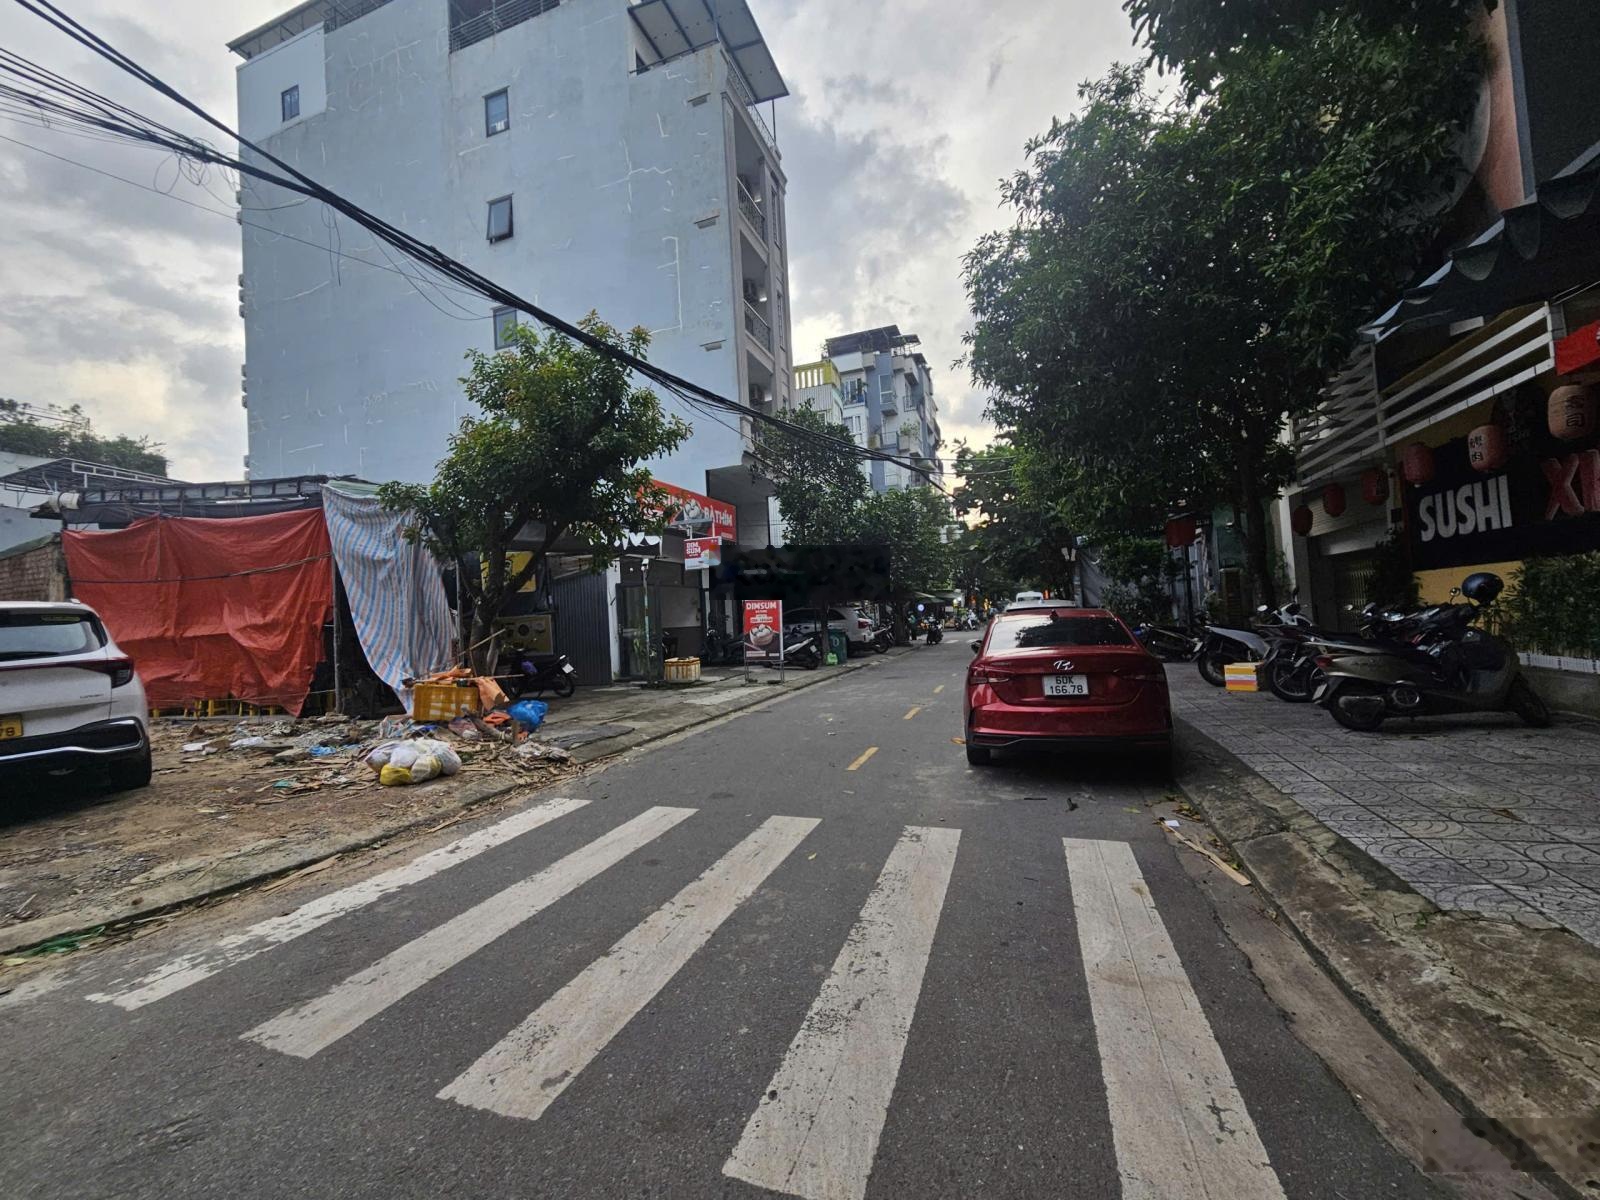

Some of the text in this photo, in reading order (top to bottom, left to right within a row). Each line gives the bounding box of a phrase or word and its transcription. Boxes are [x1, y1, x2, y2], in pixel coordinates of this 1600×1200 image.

[1418, 475, 1513, 543] SUSHI
[1055, 675, 1074, 684] 60K
[1050, 685, 1083, 694] 166.78
